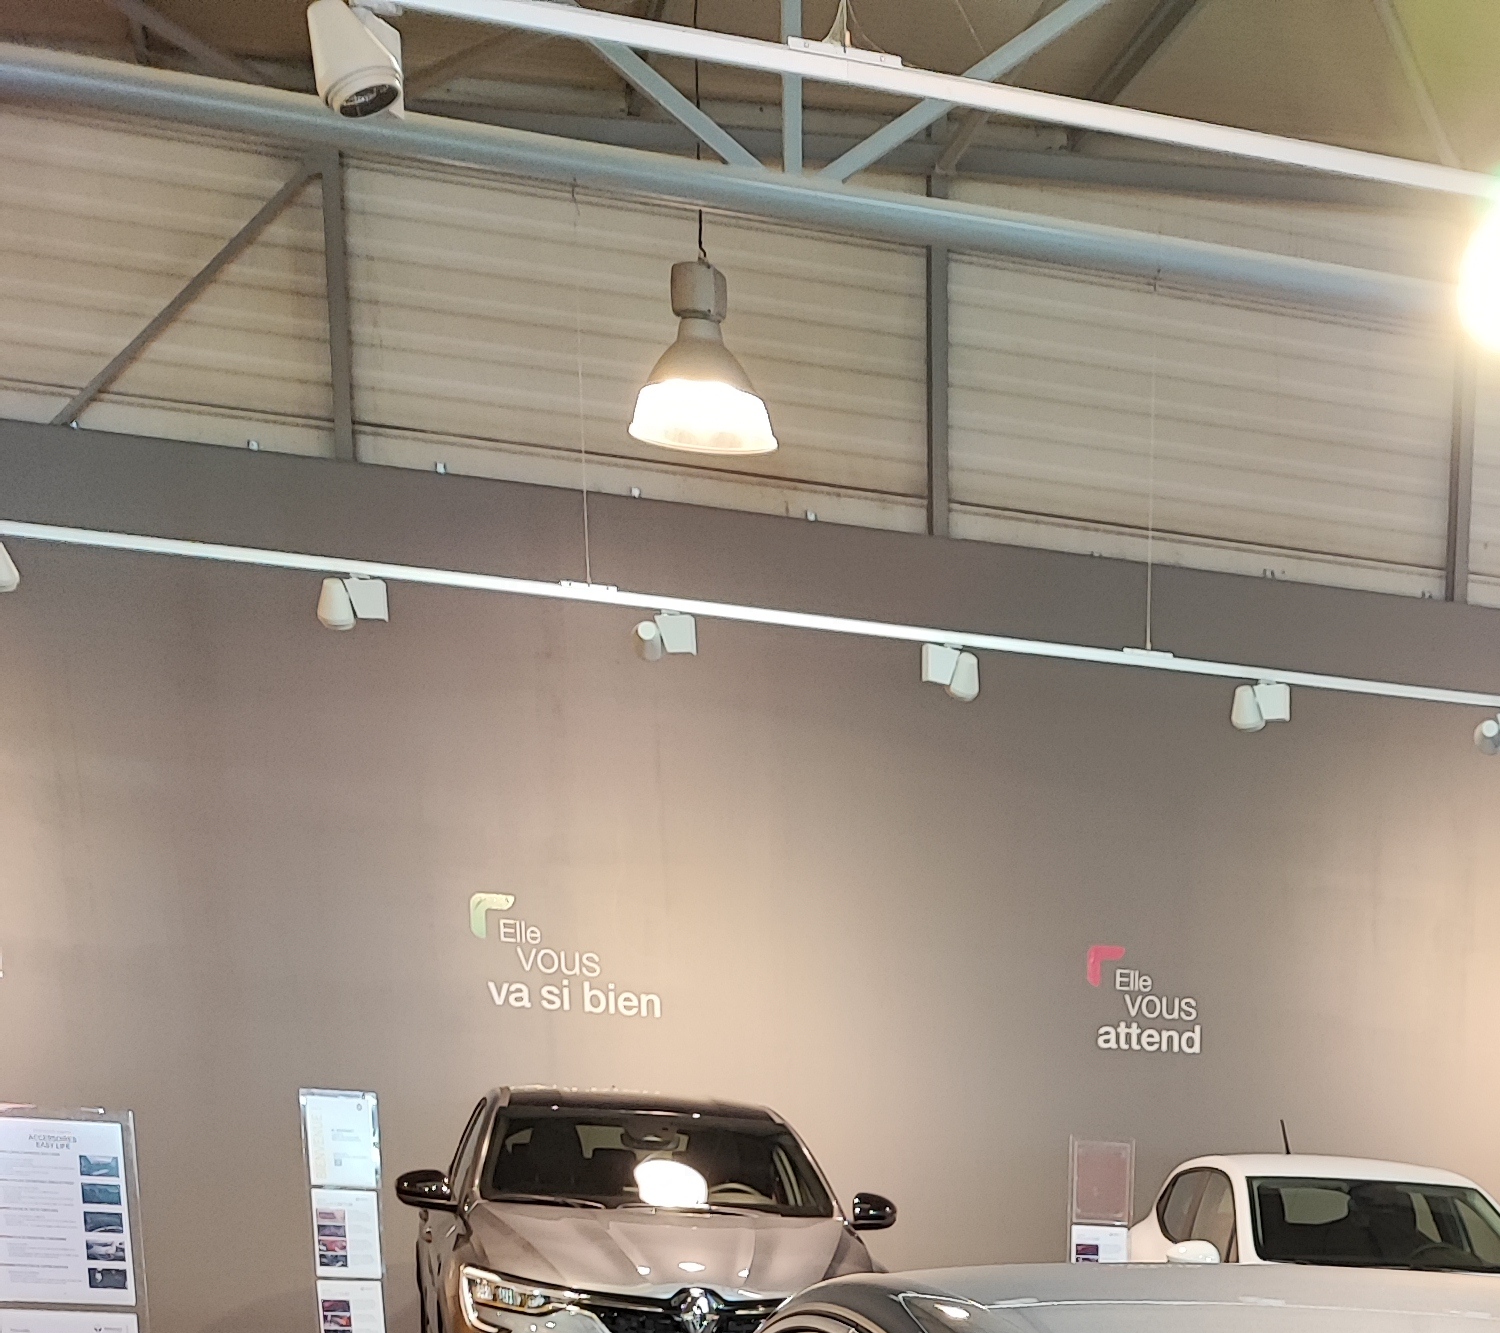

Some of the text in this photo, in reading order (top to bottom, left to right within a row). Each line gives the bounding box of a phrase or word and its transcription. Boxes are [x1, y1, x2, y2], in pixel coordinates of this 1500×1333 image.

[499, 918, 541, 944] Elle
[516, 946, 601, 977] vous
[1115, 968, 1153, 992] Elle
[487, 978, 662, 1018] va si bien
[1124, 993, 1198, 1021] vous
[1097, 1021, 1201, 1054] attend
